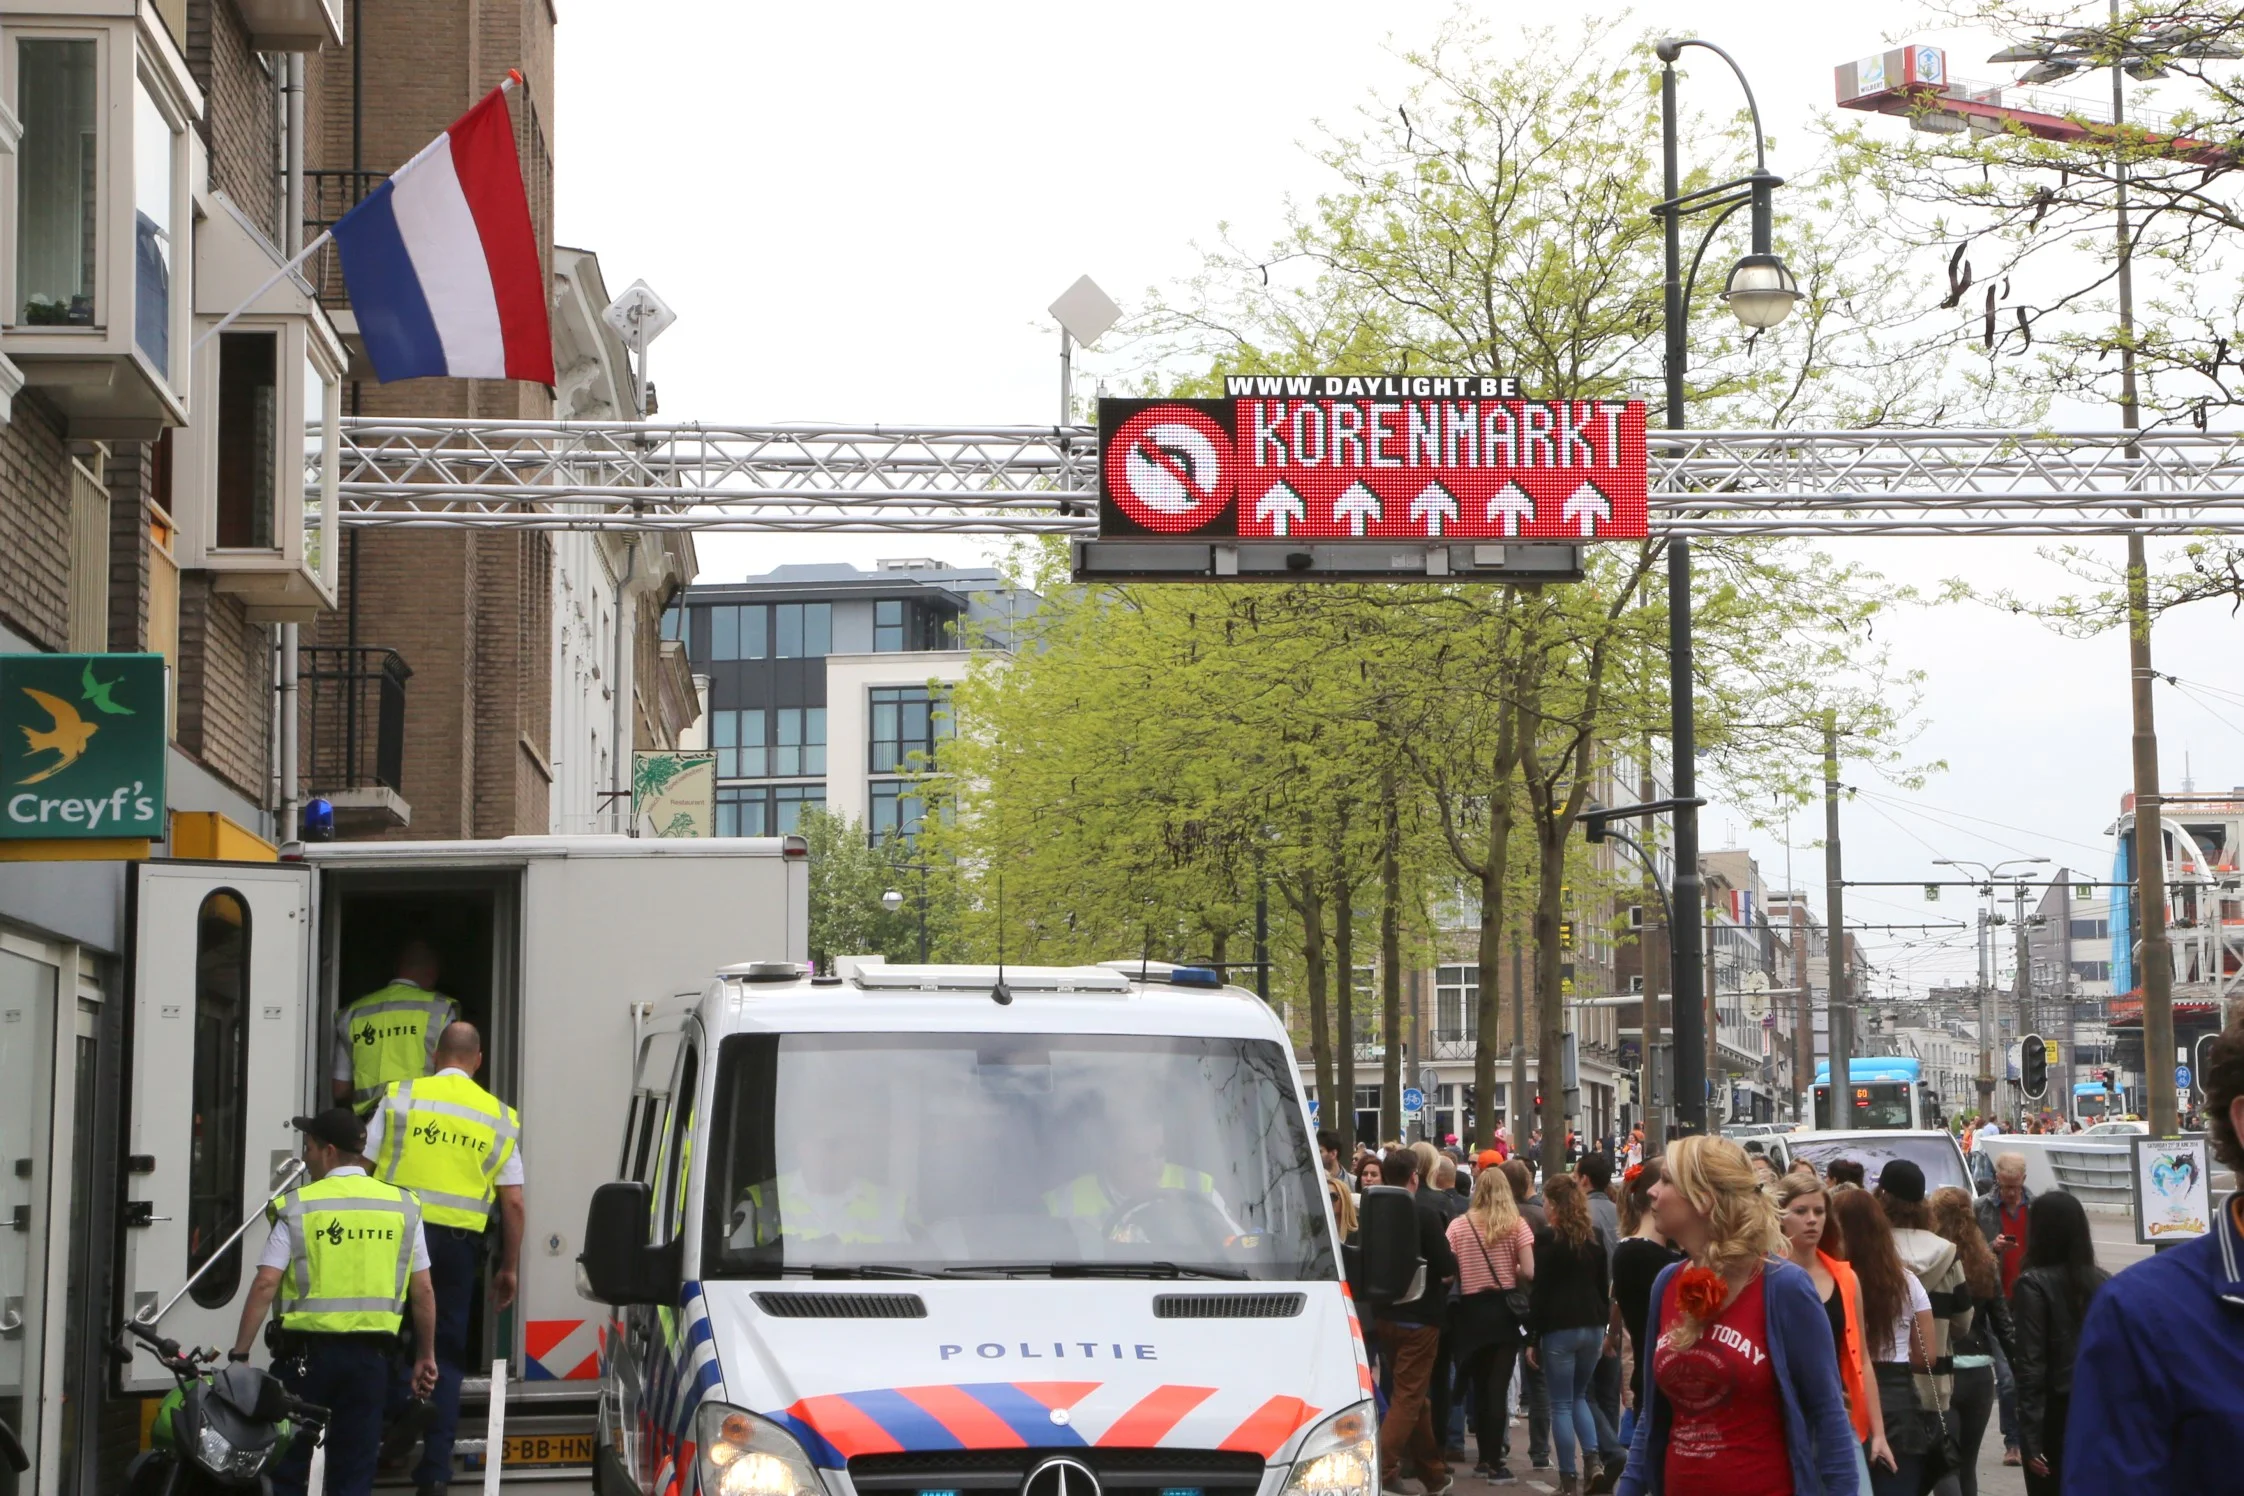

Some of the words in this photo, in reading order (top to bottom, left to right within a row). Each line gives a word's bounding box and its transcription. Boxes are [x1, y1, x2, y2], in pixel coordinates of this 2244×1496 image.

[1227, 377, 1516, 397] WWW.DAYLIGHT.BE
[1253, 400, 1626, 469] KORENMARKT
[8, 781, 154, 829] Creyf's
[939, 1342, 1158, 1361] POLITIE
[1711, 1324, 1766, 1366] TODAY
